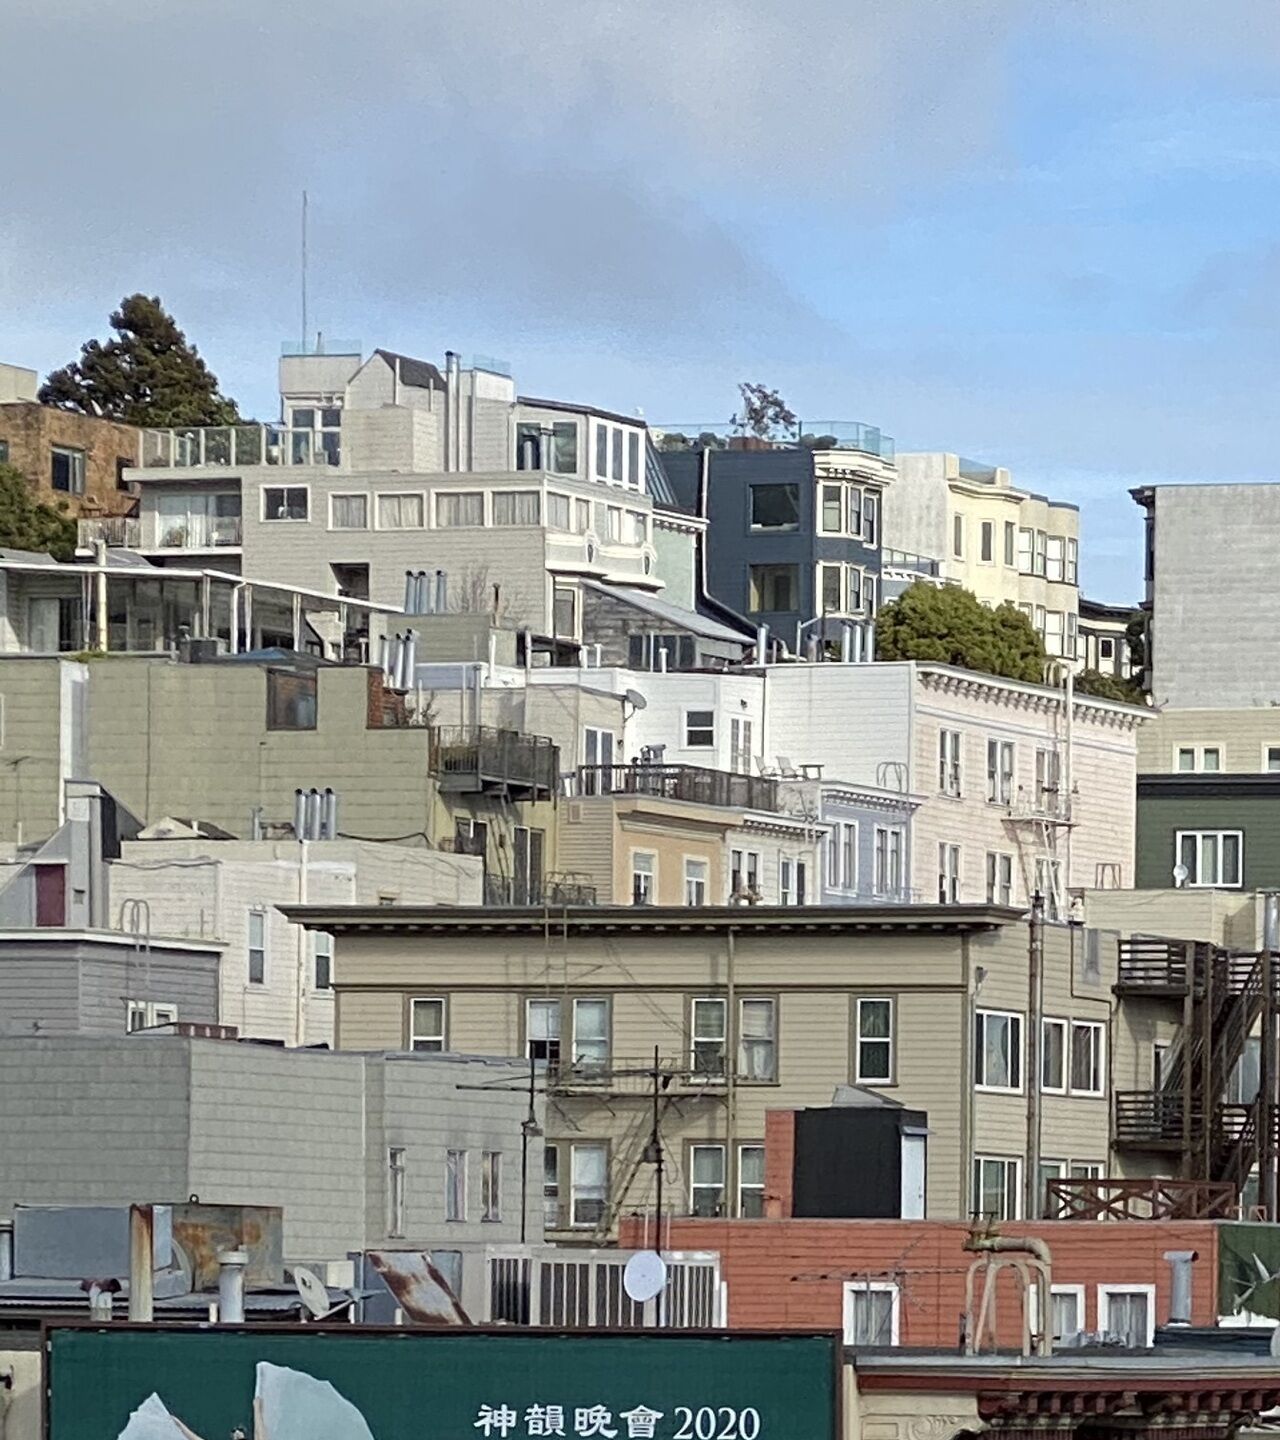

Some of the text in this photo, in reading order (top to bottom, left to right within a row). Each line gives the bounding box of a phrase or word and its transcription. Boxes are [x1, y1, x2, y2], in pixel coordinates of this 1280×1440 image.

[473, 1403, 761, 1440] 神韻晚會 2020
